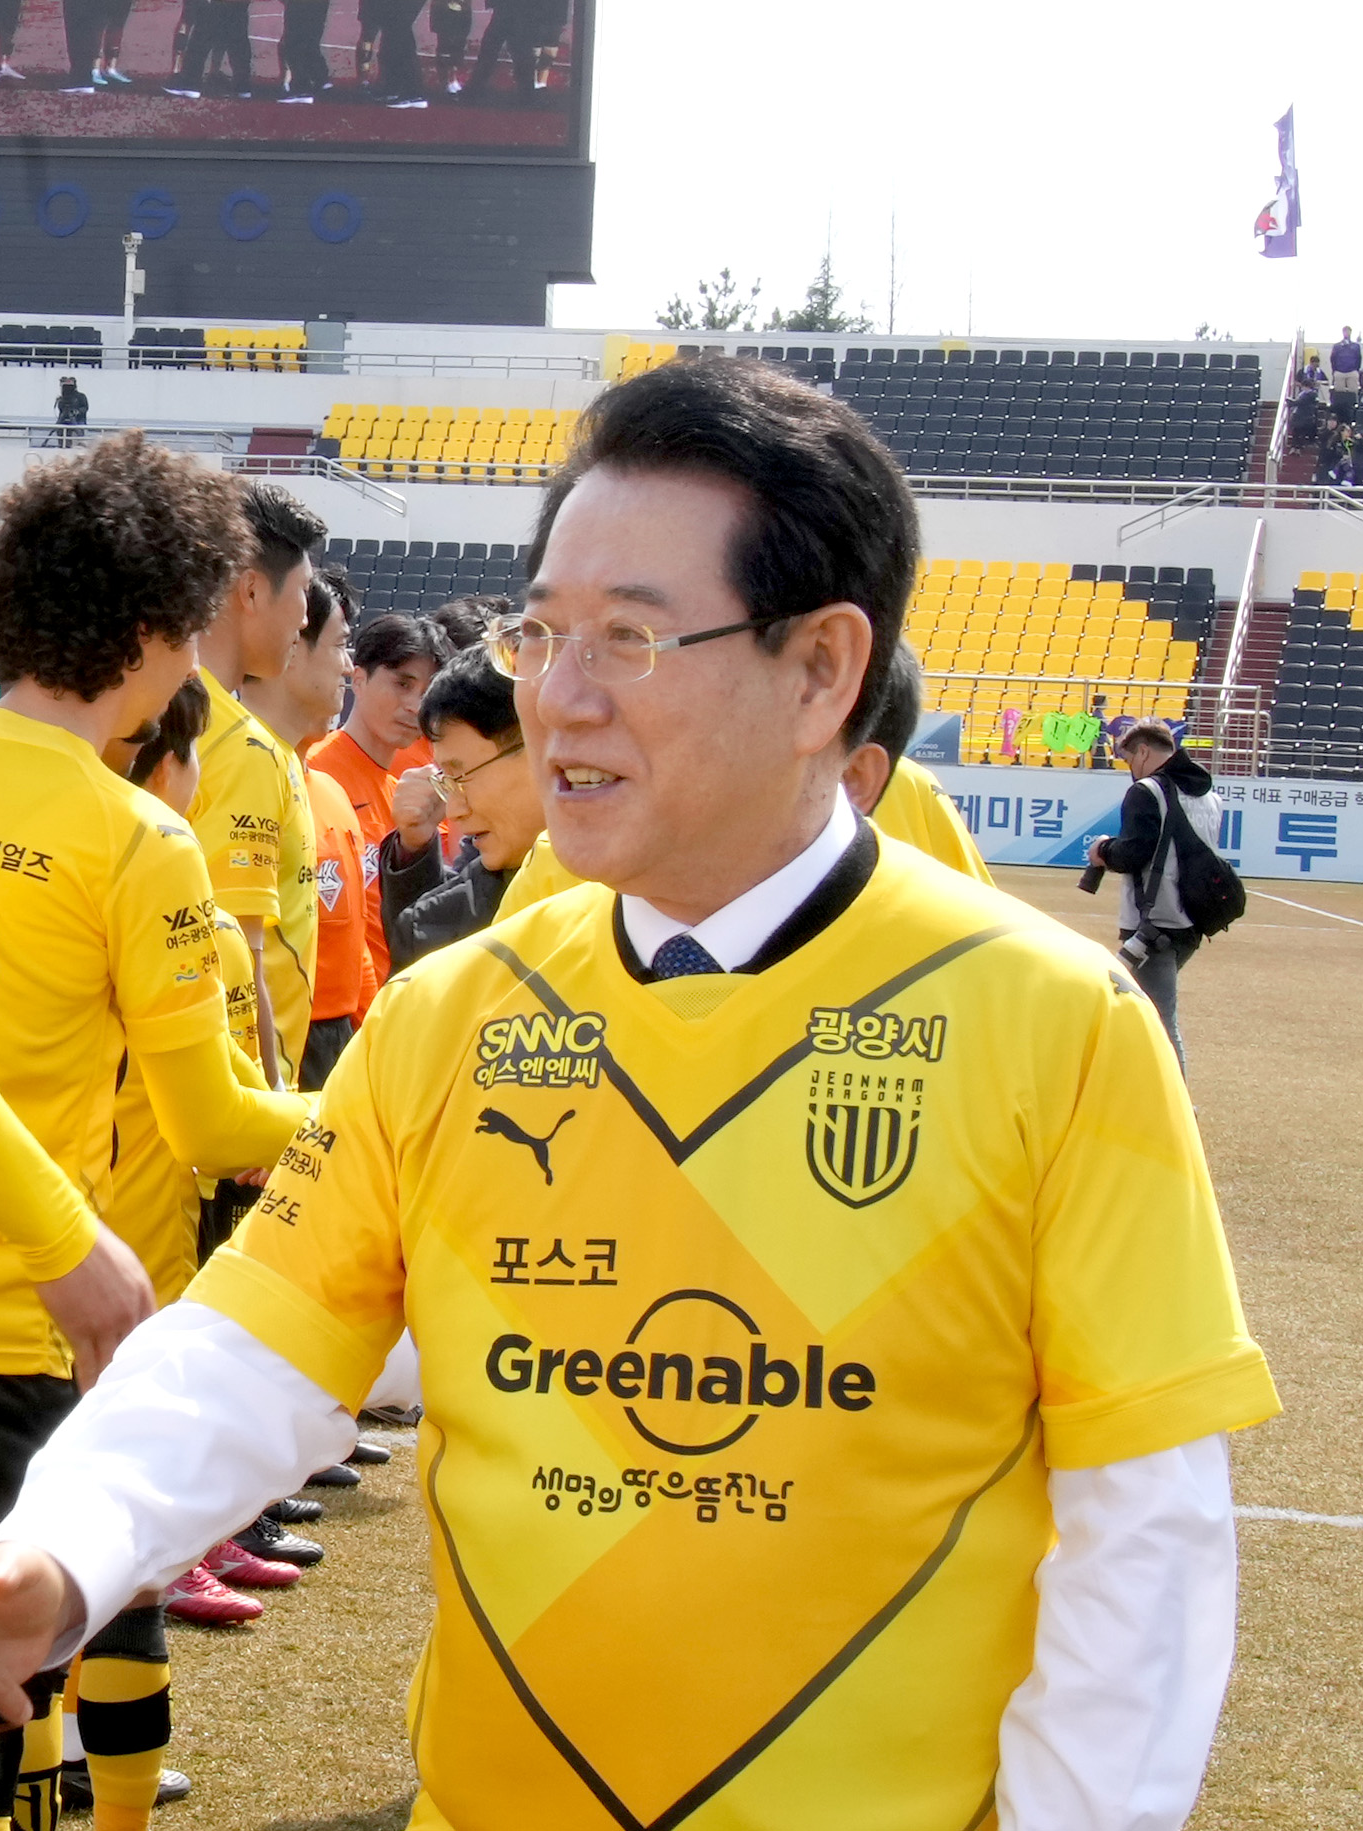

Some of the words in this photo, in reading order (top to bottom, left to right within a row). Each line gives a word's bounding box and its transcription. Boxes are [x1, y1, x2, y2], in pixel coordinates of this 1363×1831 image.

[1213, 785, 1246, 803] 민국
[1253, 788, 1282, 804] 대표
[1288, 789, 1349, 808] 구매공급
[480, 1014, 604, 1061] SNNC
[808, 1010, 944, 1061] 광양시
[476, 1056, 599, 1088] 에스엔엔씨
[811, 1070, 924, 1093] JEONNAM
[809, 1086, 923, 1106] DRAGONS
[257, 1189, 301, 1227] 남도
[490, 1237, 618, 1286] 포스코
[485, 1333, 876, 1412] Greenable
